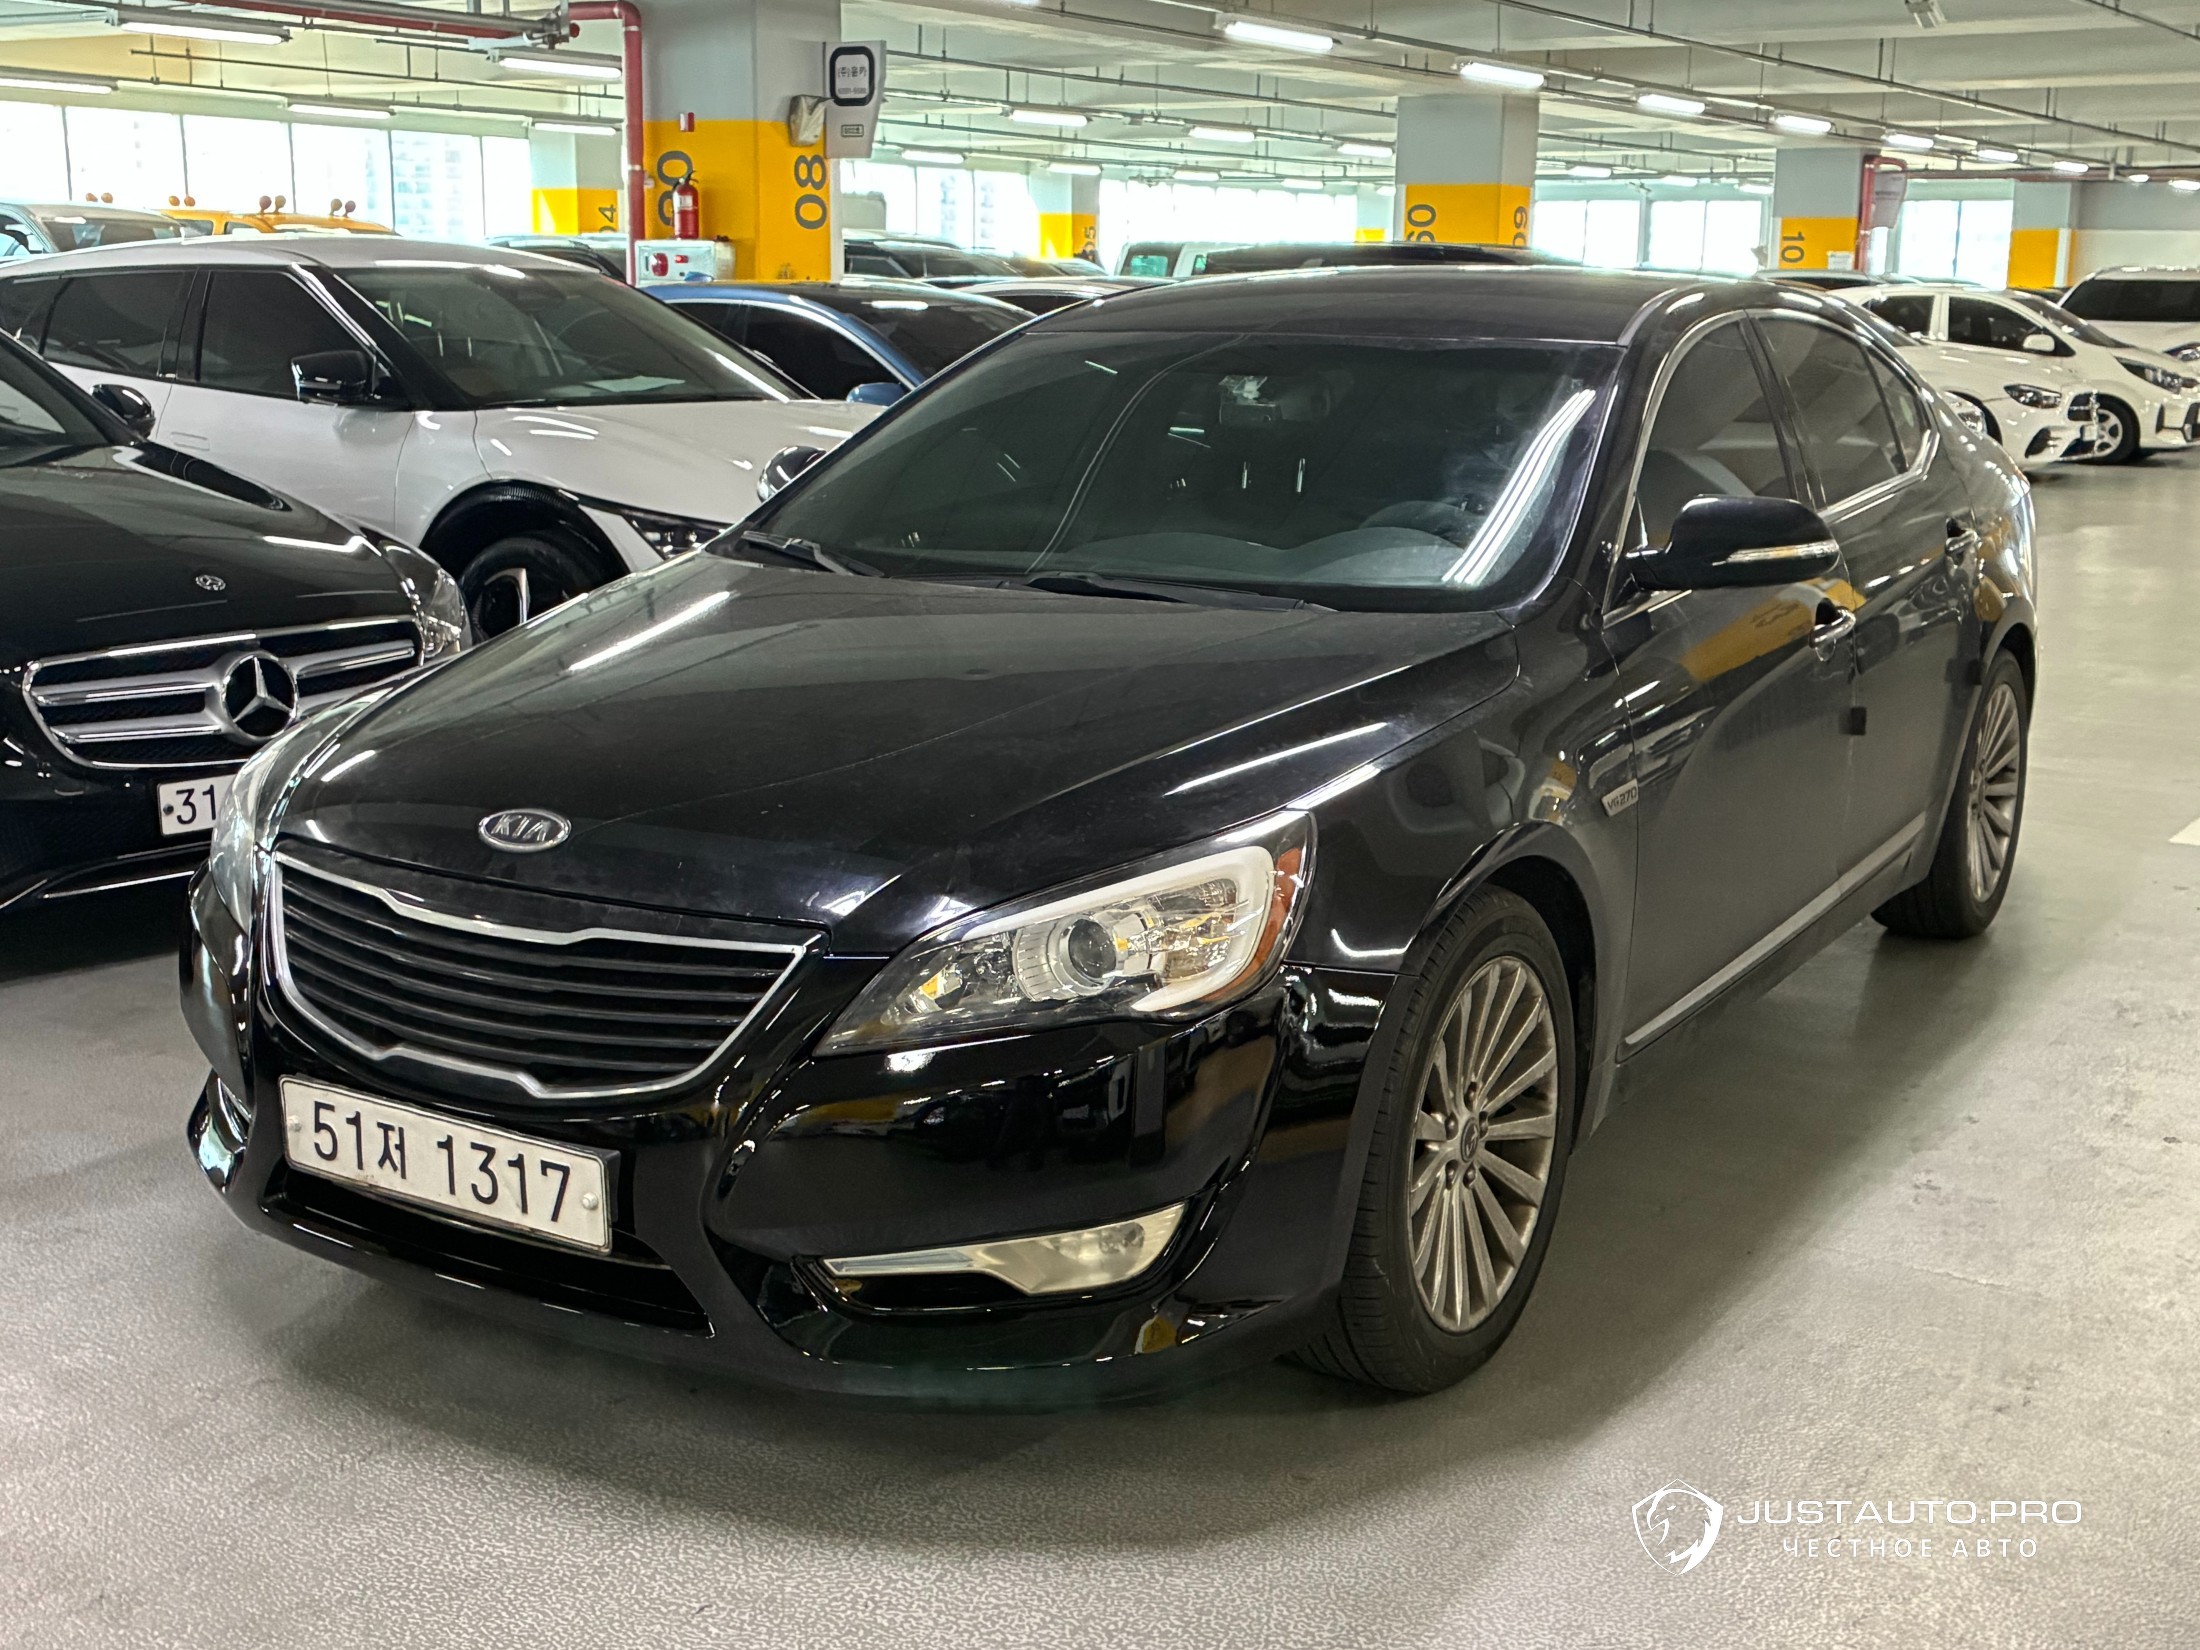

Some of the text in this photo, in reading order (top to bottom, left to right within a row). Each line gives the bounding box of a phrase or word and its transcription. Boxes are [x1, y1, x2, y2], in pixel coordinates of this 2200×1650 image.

[794, 154, 828, 230] 08
[1781, 231, 1805, 263] 10
[176, 784, 216, 825] 31
[490, 814, 552, 842] KIA
[314, 1101, 571, 1222] 51저 1317
